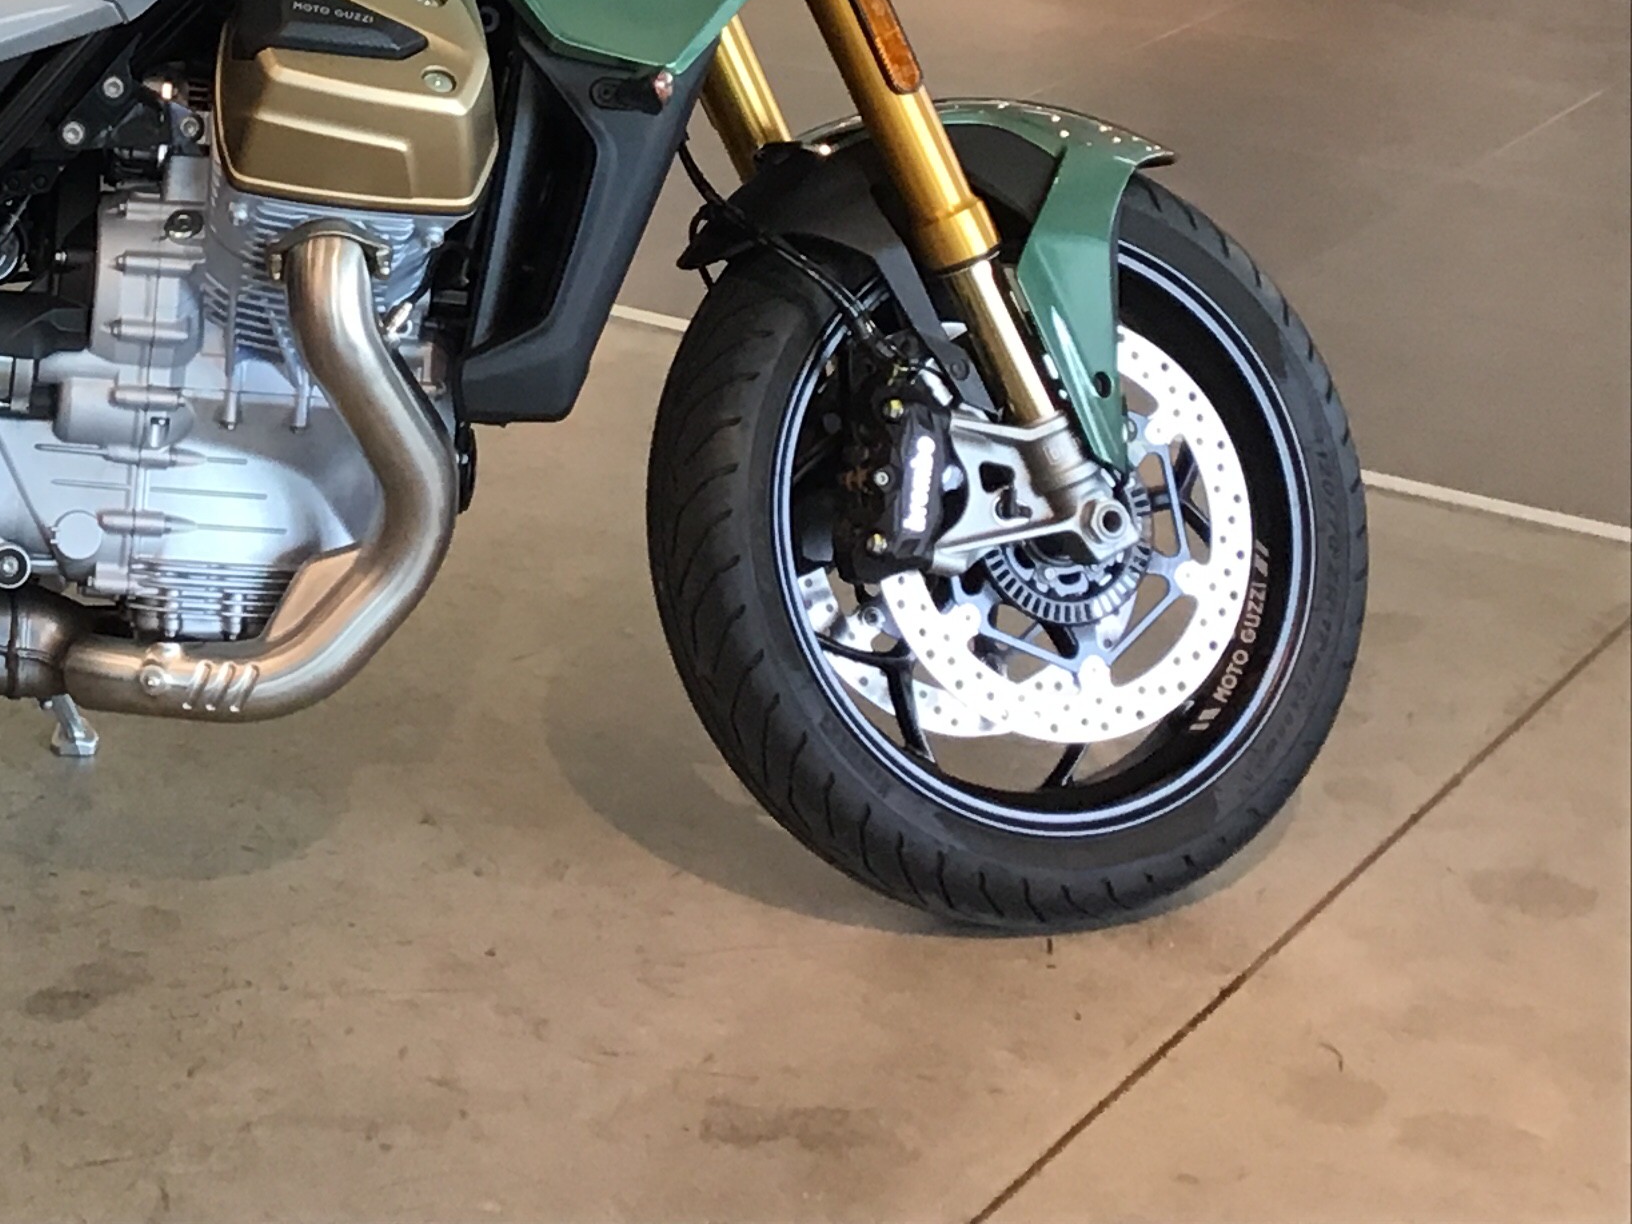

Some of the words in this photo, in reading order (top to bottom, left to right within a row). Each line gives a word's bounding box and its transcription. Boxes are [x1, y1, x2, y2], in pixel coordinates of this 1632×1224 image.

[292, 0, 331, 16] MOTO
[333, 8, 375, 24] GUZZI
[1212, 648, 1250, 704] MOTO
[1239, 581, 1268, 644] GUZZI
